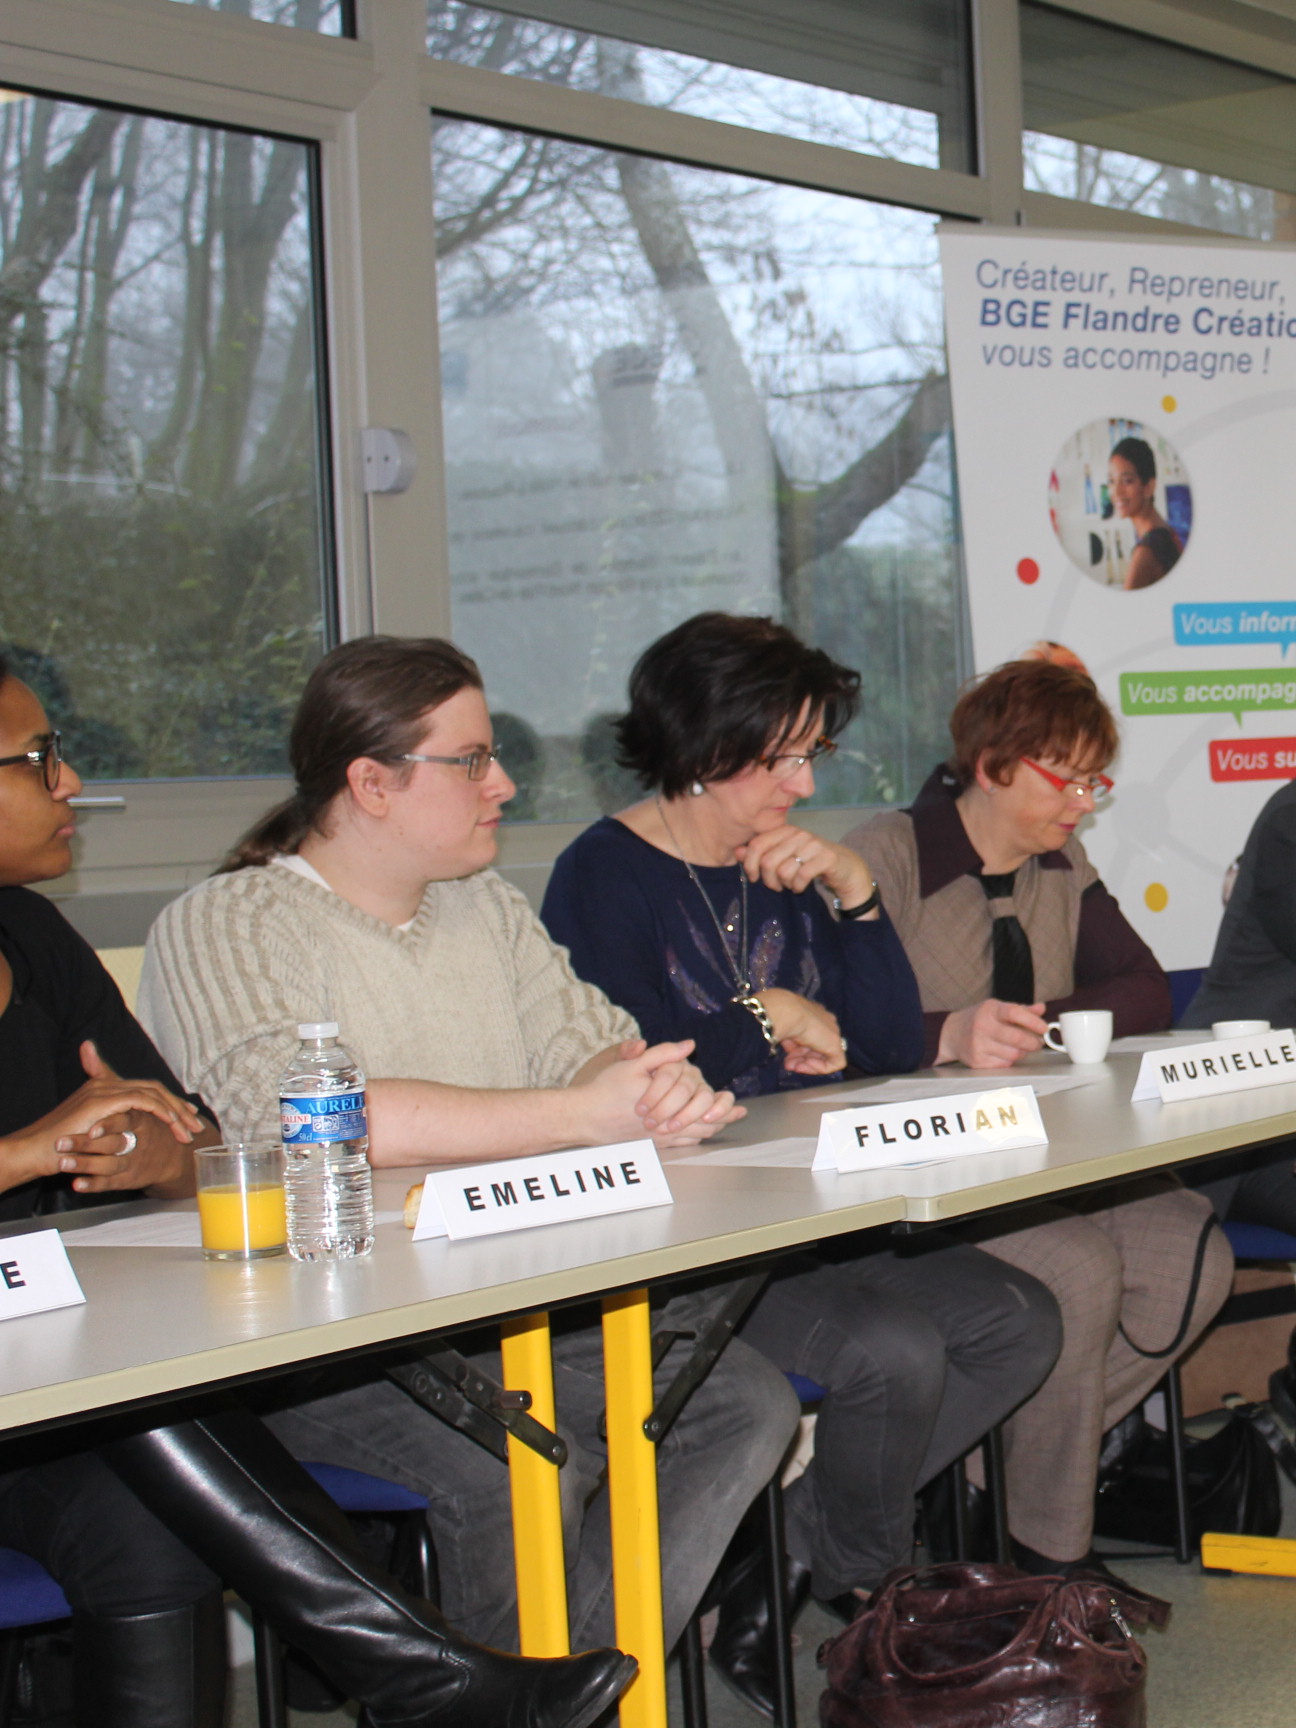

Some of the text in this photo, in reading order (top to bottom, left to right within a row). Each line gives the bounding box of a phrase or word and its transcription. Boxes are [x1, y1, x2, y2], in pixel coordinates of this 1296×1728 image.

[976, 259, 1286, 304] Créateur, Repreneur,
[980, 299, 1051, 329] BGE
[1062, 304, 1181, 334] Flandre
[982, 344, 1052, 368] vous
[1063, 346, 1253, 379] accompagne
[1181, 612, 1233, 634] Vous
[1127, 682, 1178, 704] Vous
[1217, 749, 1268, 771] Vous
[1160, 1045, 1296, 1084] MURIELLE
[854, 1104, 1019, 1148] FLORIAN
[463, 1161, 641, 1212] EMELINE
[0, 1260, 27, 1290] E
